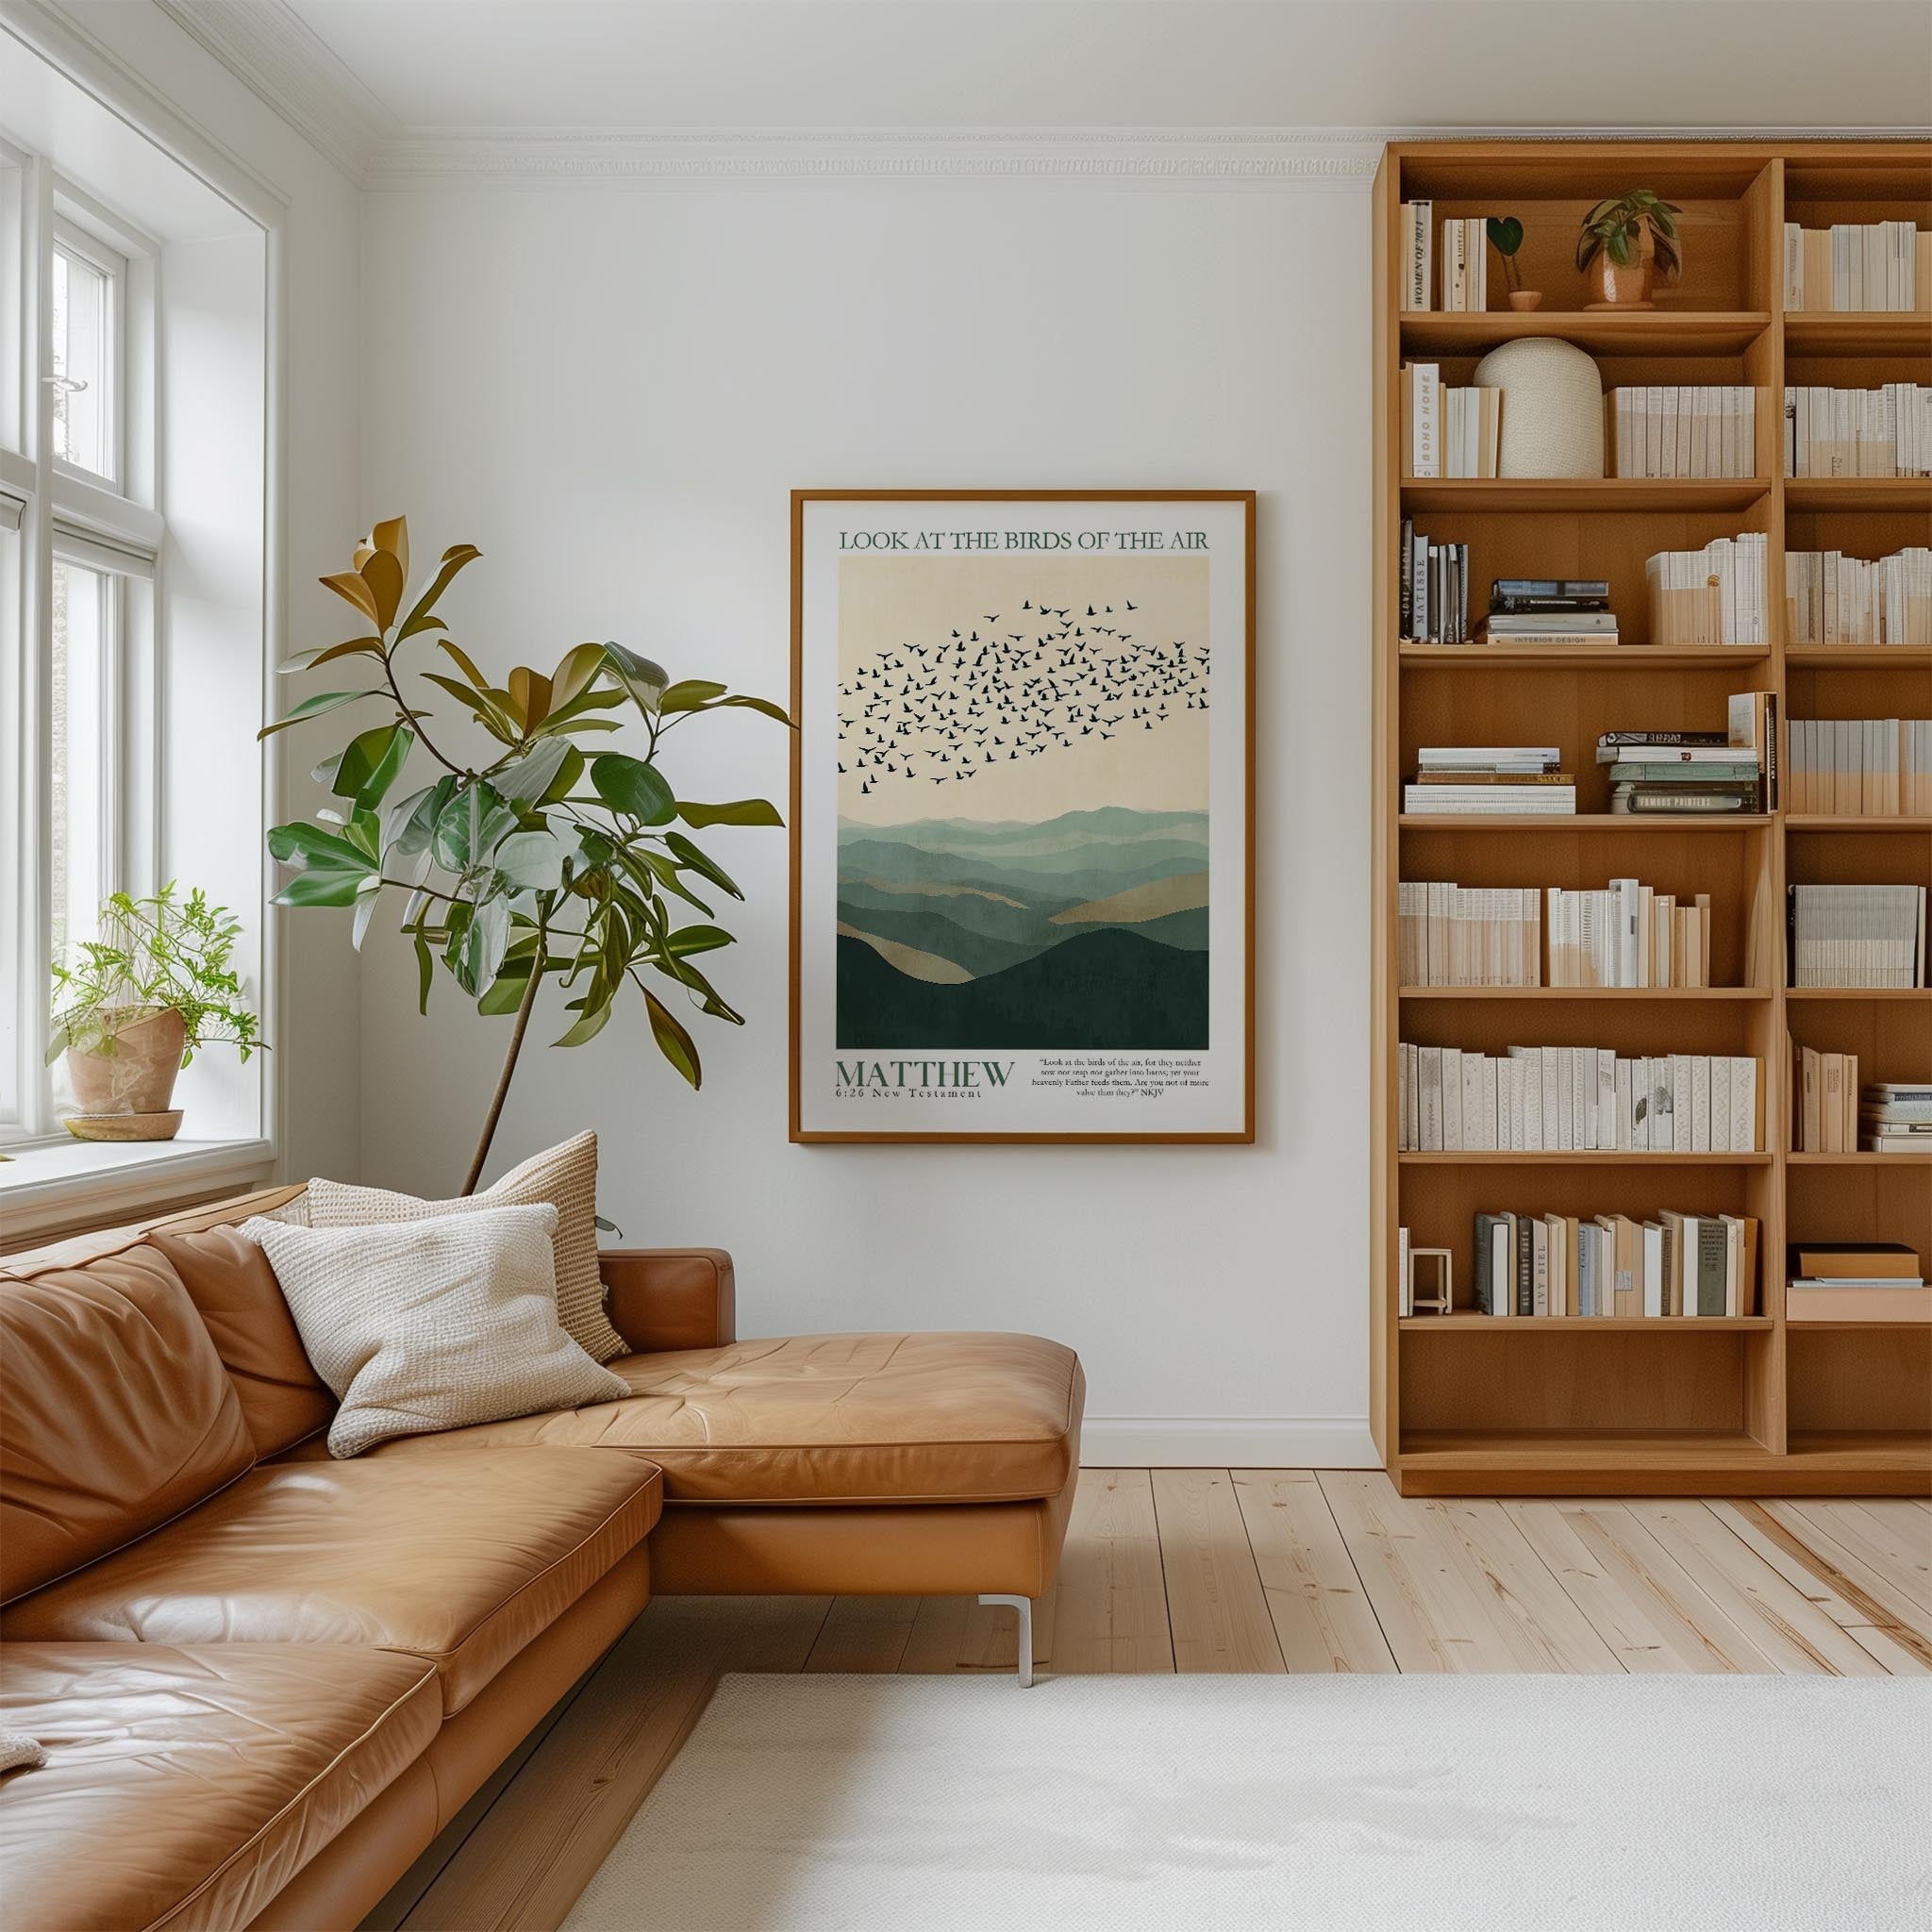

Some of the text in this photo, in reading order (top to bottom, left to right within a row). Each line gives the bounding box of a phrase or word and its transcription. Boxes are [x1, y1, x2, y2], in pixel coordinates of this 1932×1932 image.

[1415, 246, 1424, 260] OF
[1414, 264, 1423, 305] WOMEN
[1422, 375, 1430, 414] HOME
[1422, 422, 1430, 461] BOHO
[840, 532, 1209, 550] LOOK AT THE BIRDS OF THE AIR
[1416, 559, 1425, 624] MATISSE
[1640, 797, 1710, 807] FAMOUS PAINTERS
[1158, 1058, 1173, 1068] they
[836, 1061, 1015, 1087] MATTHEW
[1073, 1070, 1088, 1078] reap
[1105, 1068, 1127, 1077] gather
[1170, 1070, 1181, 1078] yet
[1183, 1070, 1200, 1078] your
[908, 1089, 981, 1098] Testament
[1141, 1089, 1164, 1098] NKJV
